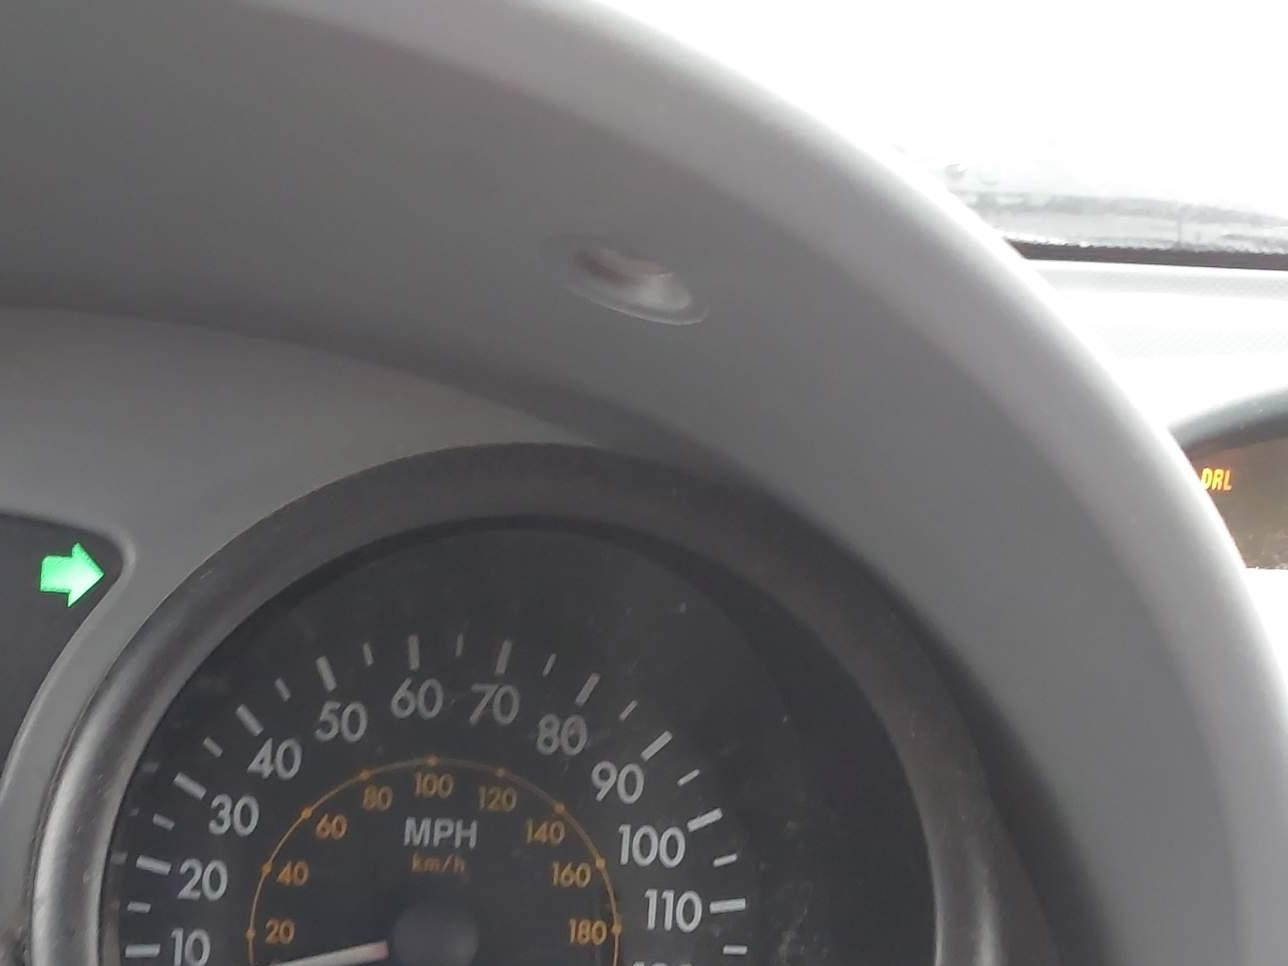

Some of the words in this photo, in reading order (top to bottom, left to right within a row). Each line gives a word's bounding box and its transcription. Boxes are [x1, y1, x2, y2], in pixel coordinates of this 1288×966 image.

[1201, 467, 1233, 491] DRL
[390, 678, 444, 719] 60
[469, 683, 521, 725] 70
[314, 701, 368, 742] 50
[536, 714, 588, 756] 80
[247, 738, 302, 780] 40
[415, 772, 454, 799] 100
[591, 761, 645, 804] 90
[362, 785, 393, 812] 80
[478, 785, 517, 812] 120
[208, 794, 259, 836] 30
[315, 813, 348, 840] 60
[403, 816, 478, 849] MPH
[525, 818, 566, 845] 140
[618, 824, 686, 868] 100
[276, 861, 309, 887] 40
[411, 854, 465, 873] km/h
[552, 861, 592, 888] 160
[178, 859, 228, 900] 20
[644, 889, 702, 932] 110
[264, 918, 296, 945] 20
[568, 918, 608, 945] 180
